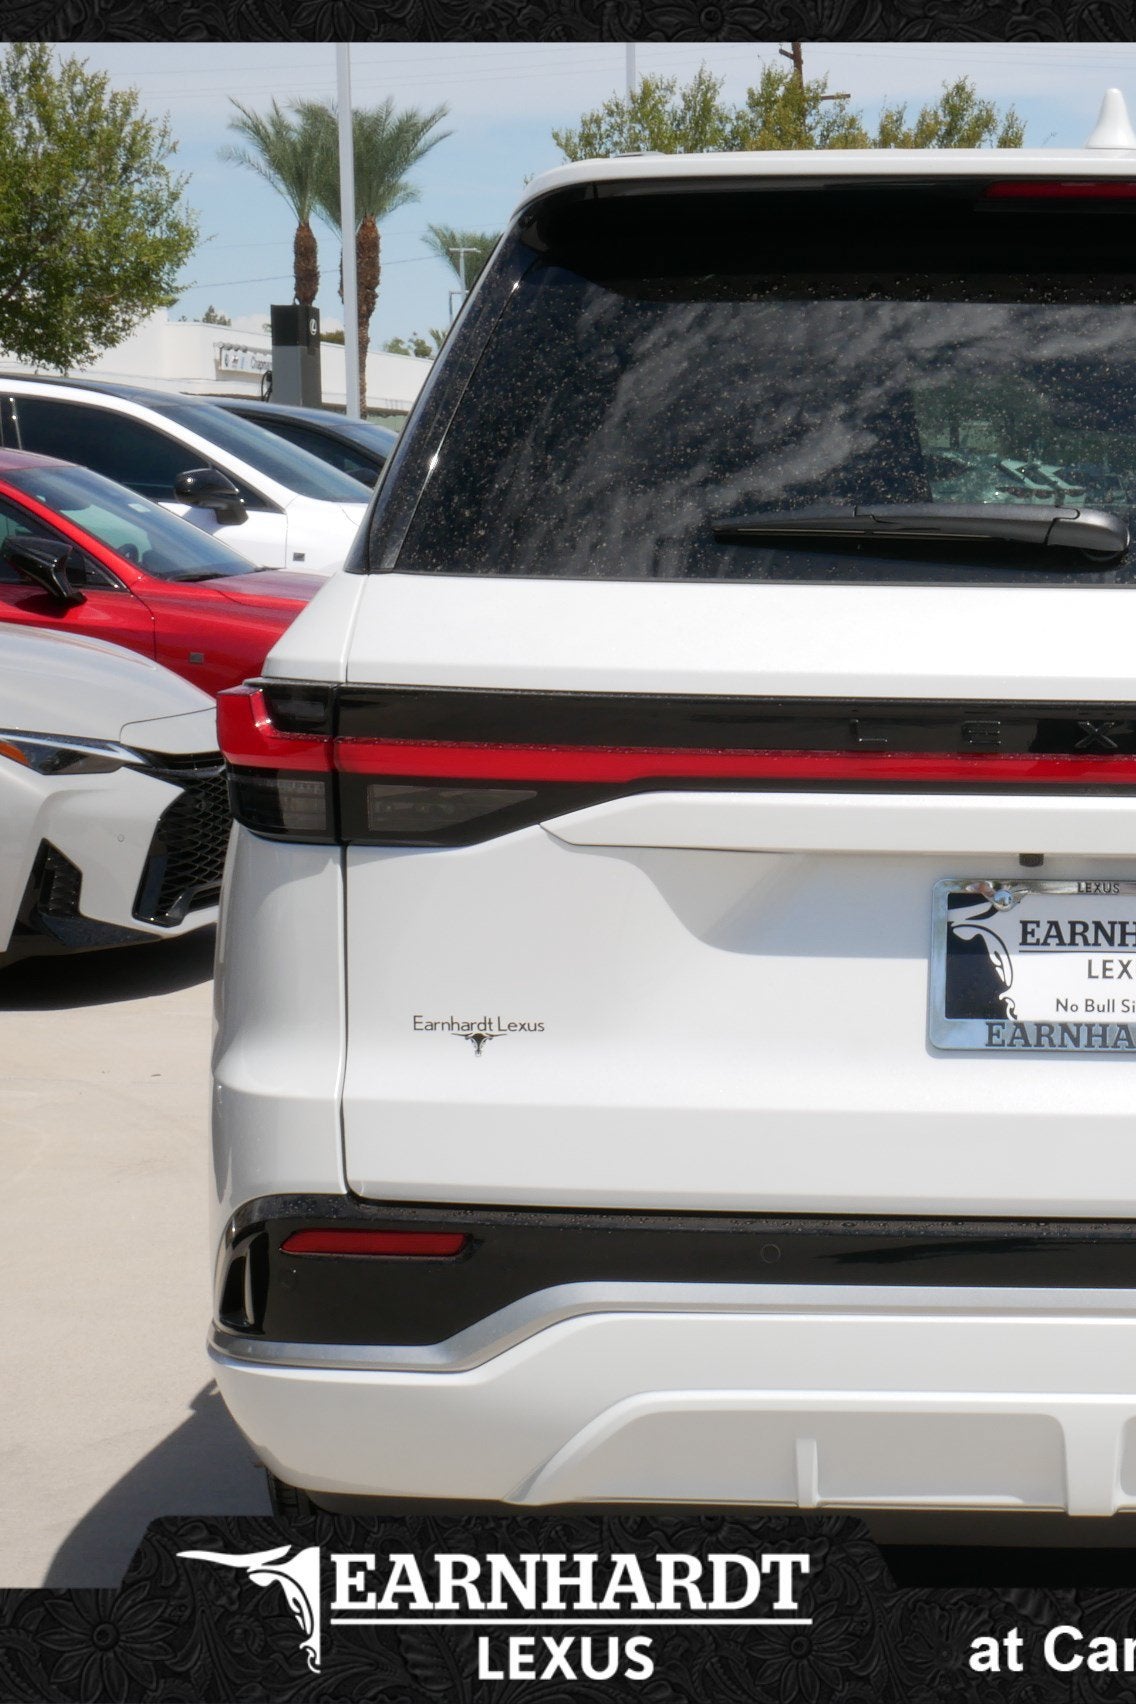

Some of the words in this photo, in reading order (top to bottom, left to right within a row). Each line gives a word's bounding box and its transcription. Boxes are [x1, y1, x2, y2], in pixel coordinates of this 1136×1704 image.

[1077, 882, 1120, 894] LEXUS
[1055, 998, 1079, 1013] No
[1085, 998, 1116, 1014] Bull
[413, 1014, 493, 1032] Earnhardt
[497, 1015, 545, 1032] Lexus
